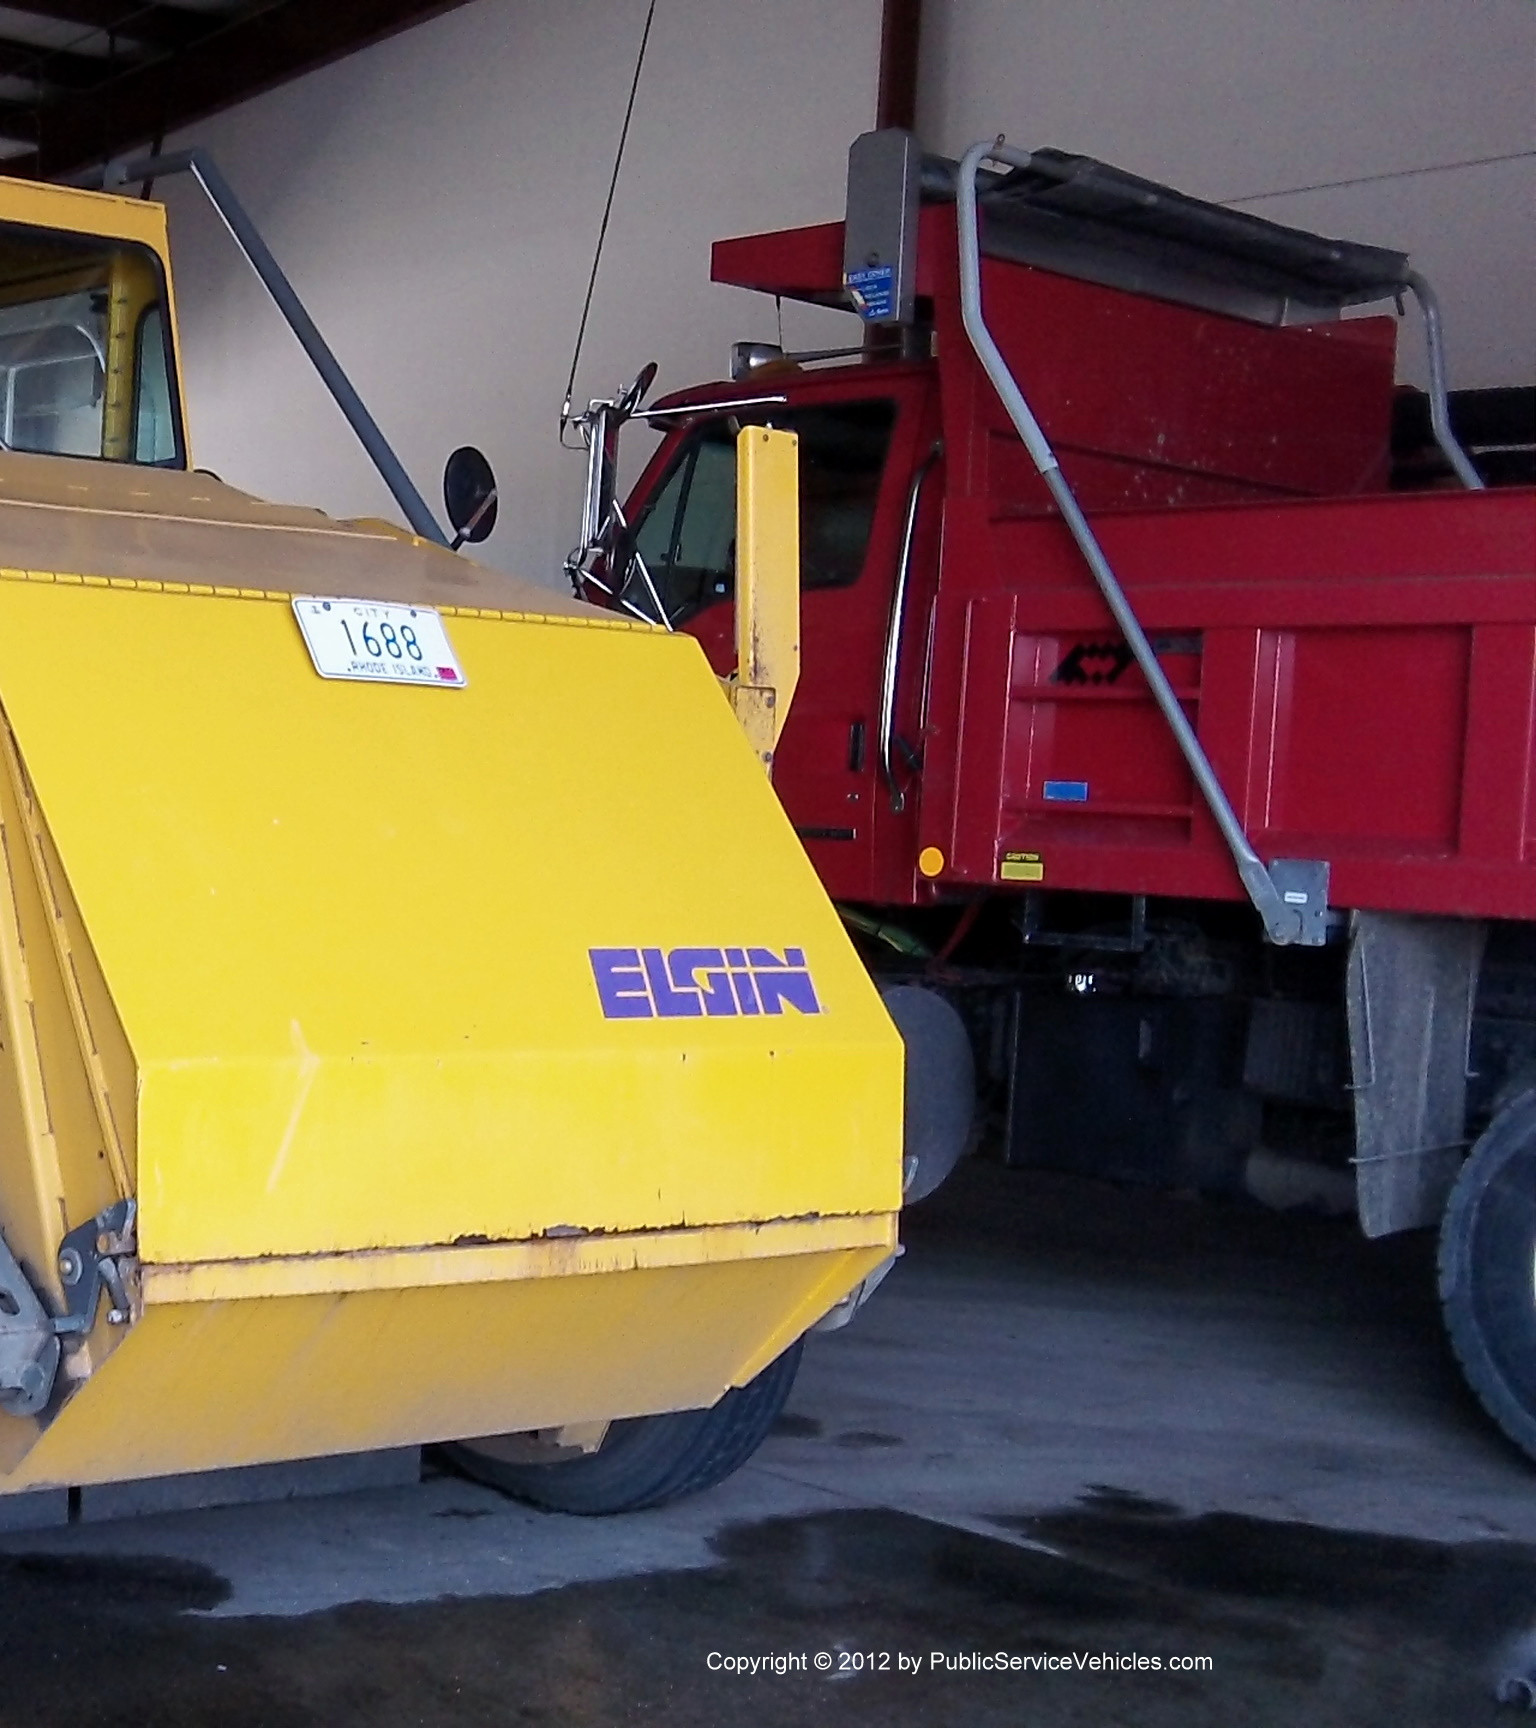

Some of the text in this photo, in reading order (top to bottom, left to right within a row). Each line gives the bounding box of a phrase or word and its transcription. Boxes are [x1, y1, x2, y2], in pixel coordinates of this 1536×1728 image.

[353, 606, 391, 620] CITY
[341, 618, 423, 661] 1688
[350, 660, 433, 678] RHODE ISLAND
[587, 947, 821, 1019] ELGIN
